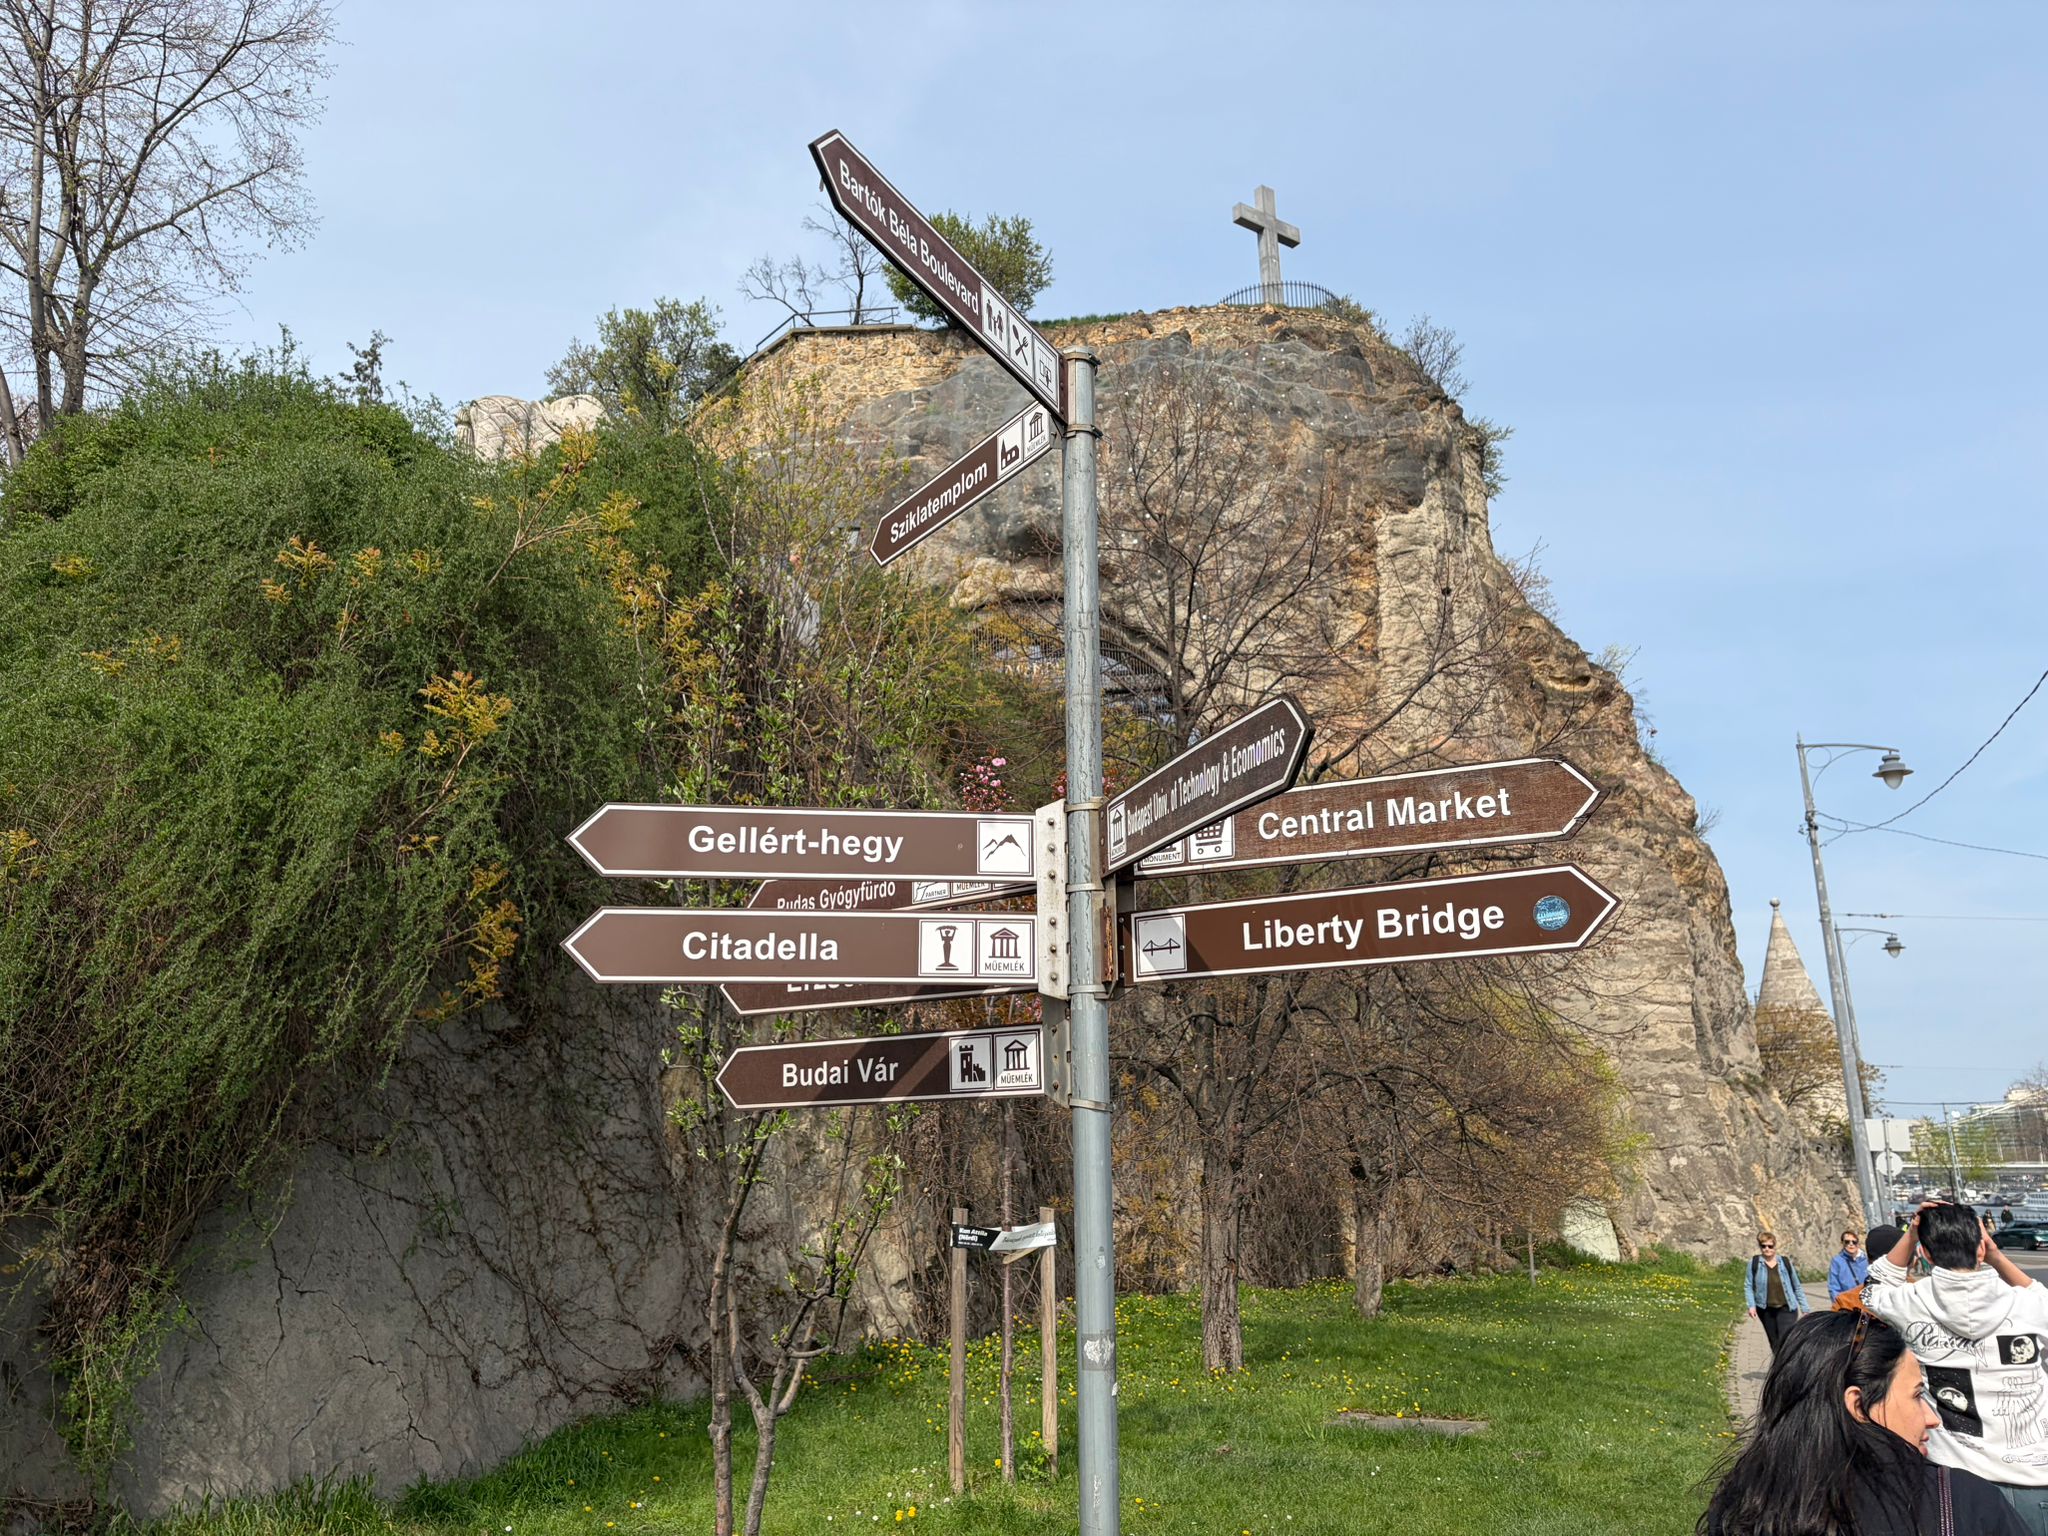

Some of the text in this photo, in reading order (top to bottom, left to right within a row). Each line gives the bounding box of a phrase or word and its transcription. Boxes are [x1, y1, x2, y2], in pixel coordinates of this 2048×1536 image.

[839, 159, 979, 316] Bartók Béla Boulevard
[890, 462, 987, 544] Sziklatemplom
[1127, 797, 1153, 836] Budapest
[1153, 787, 1170, 821] Univ.
[1171, 780, 1177, 812] of
[1178, 762, 1220, 807] Technology
[1222, 752, 1229, 783] &
[1258, 787, 1511, 840] Central Market
[688, 824, 903, 863] Gellért-hegy
[683, 931, 839, 961] Citadella
[1243, 901, 1504, 950] Liberty Bridge
[782, 1057, 899, 1088] Budai Vár
